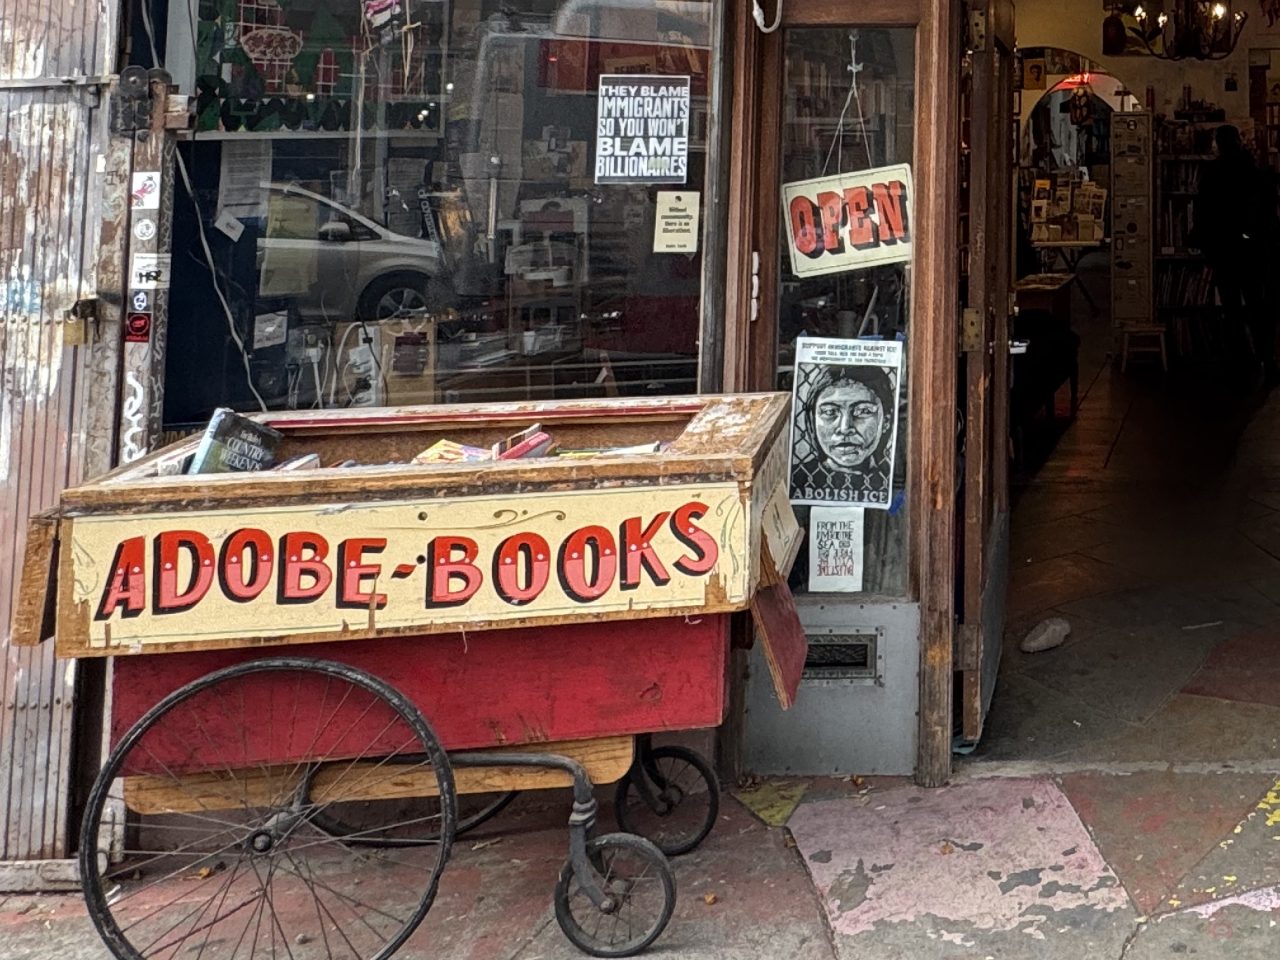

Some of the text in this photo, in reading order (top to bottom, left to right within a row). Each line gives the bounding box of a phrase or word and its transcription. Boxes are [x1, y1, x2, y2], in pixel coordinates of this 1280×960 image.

[600, 85, 689, 97] THEY BLAME
[600, 97, 689, 118] IMMIGRANTS
[599, 117, 687, 136] SO YOU WON'T
[599, 137, 687, 156] BLAME
[597, 156, 686, 177] BILLIONAIRES
[790, 180, 911, 259] OPEN
[221, 448, 262, 471] WEEKENDS
[227, 437, 265, 461] COUNTRY
[793, 487, 888, 502] ABOLISH ICE
